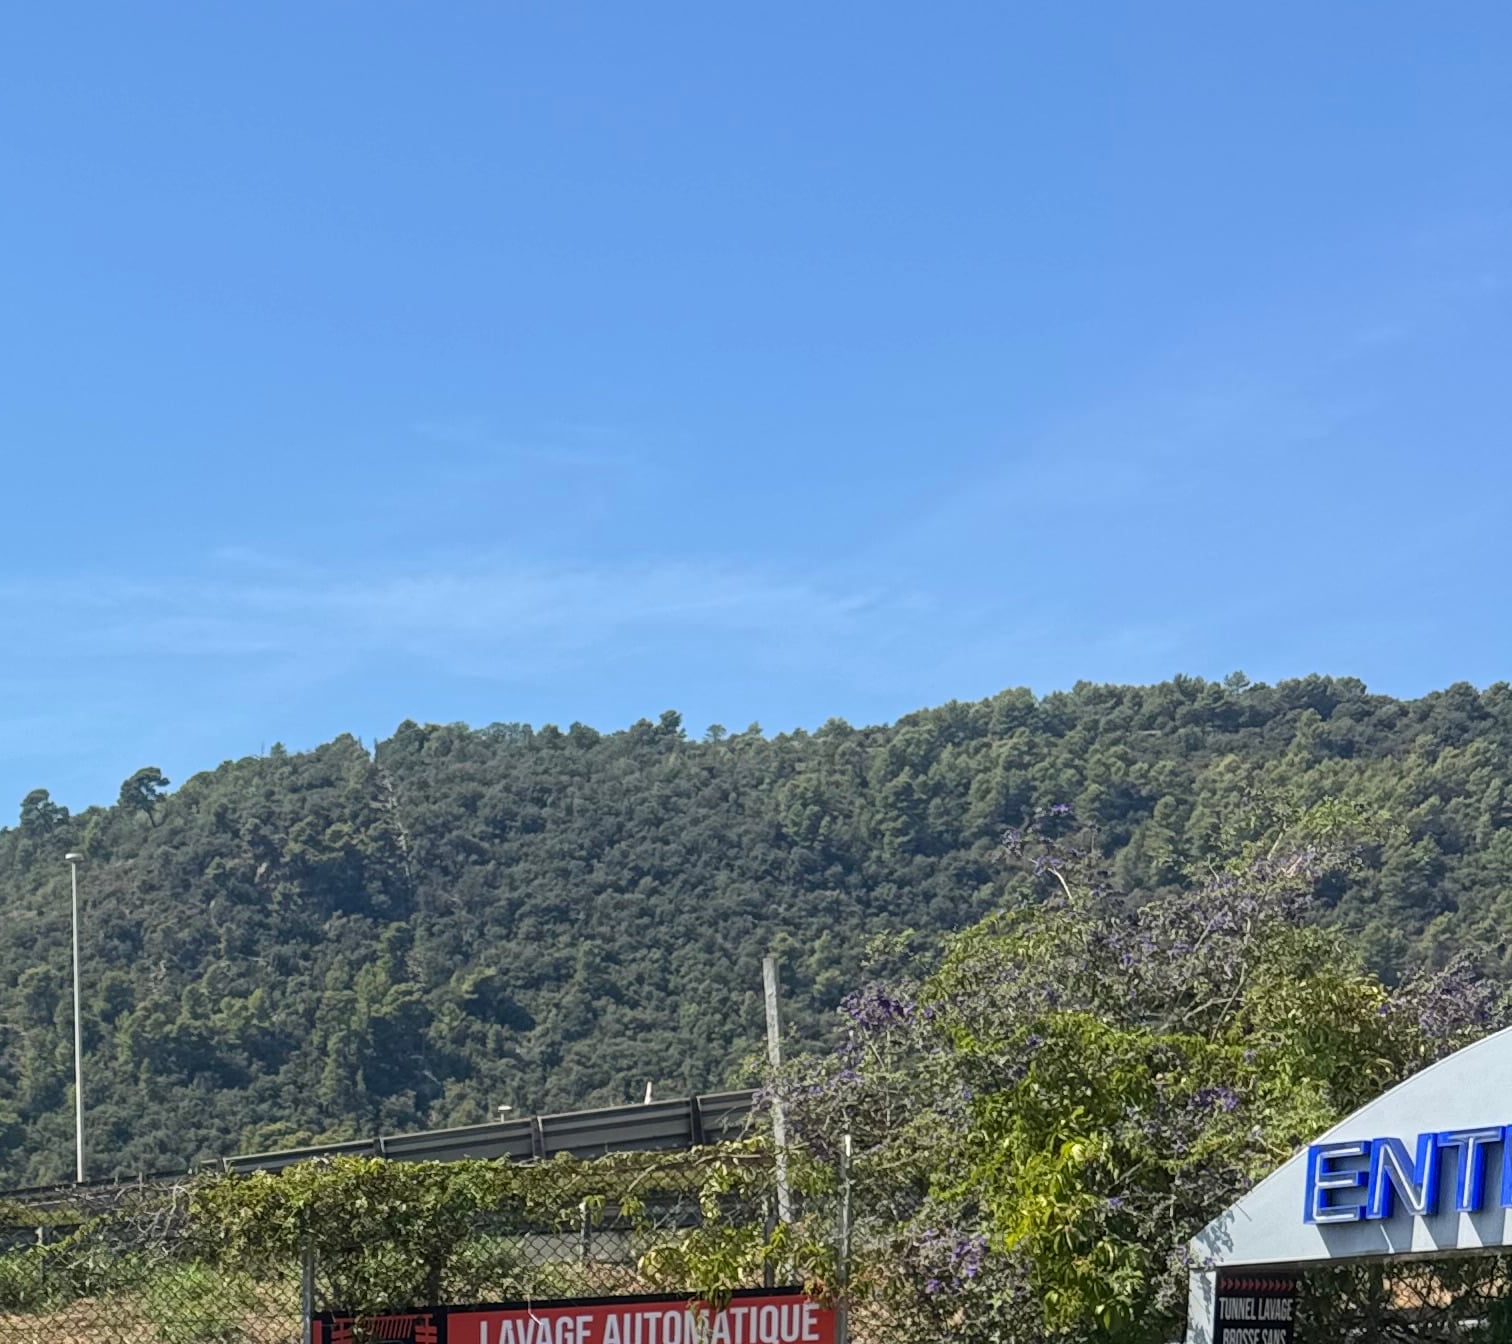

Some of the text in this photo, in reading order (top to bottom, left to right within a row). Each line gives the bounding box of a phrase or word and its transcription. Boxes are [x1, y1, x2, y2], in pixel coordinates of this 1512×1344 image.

[1304, 1124, 1512, 1224] ENT
[1219, 1297, 1294, 1321] TUNNEL LAVAGE
